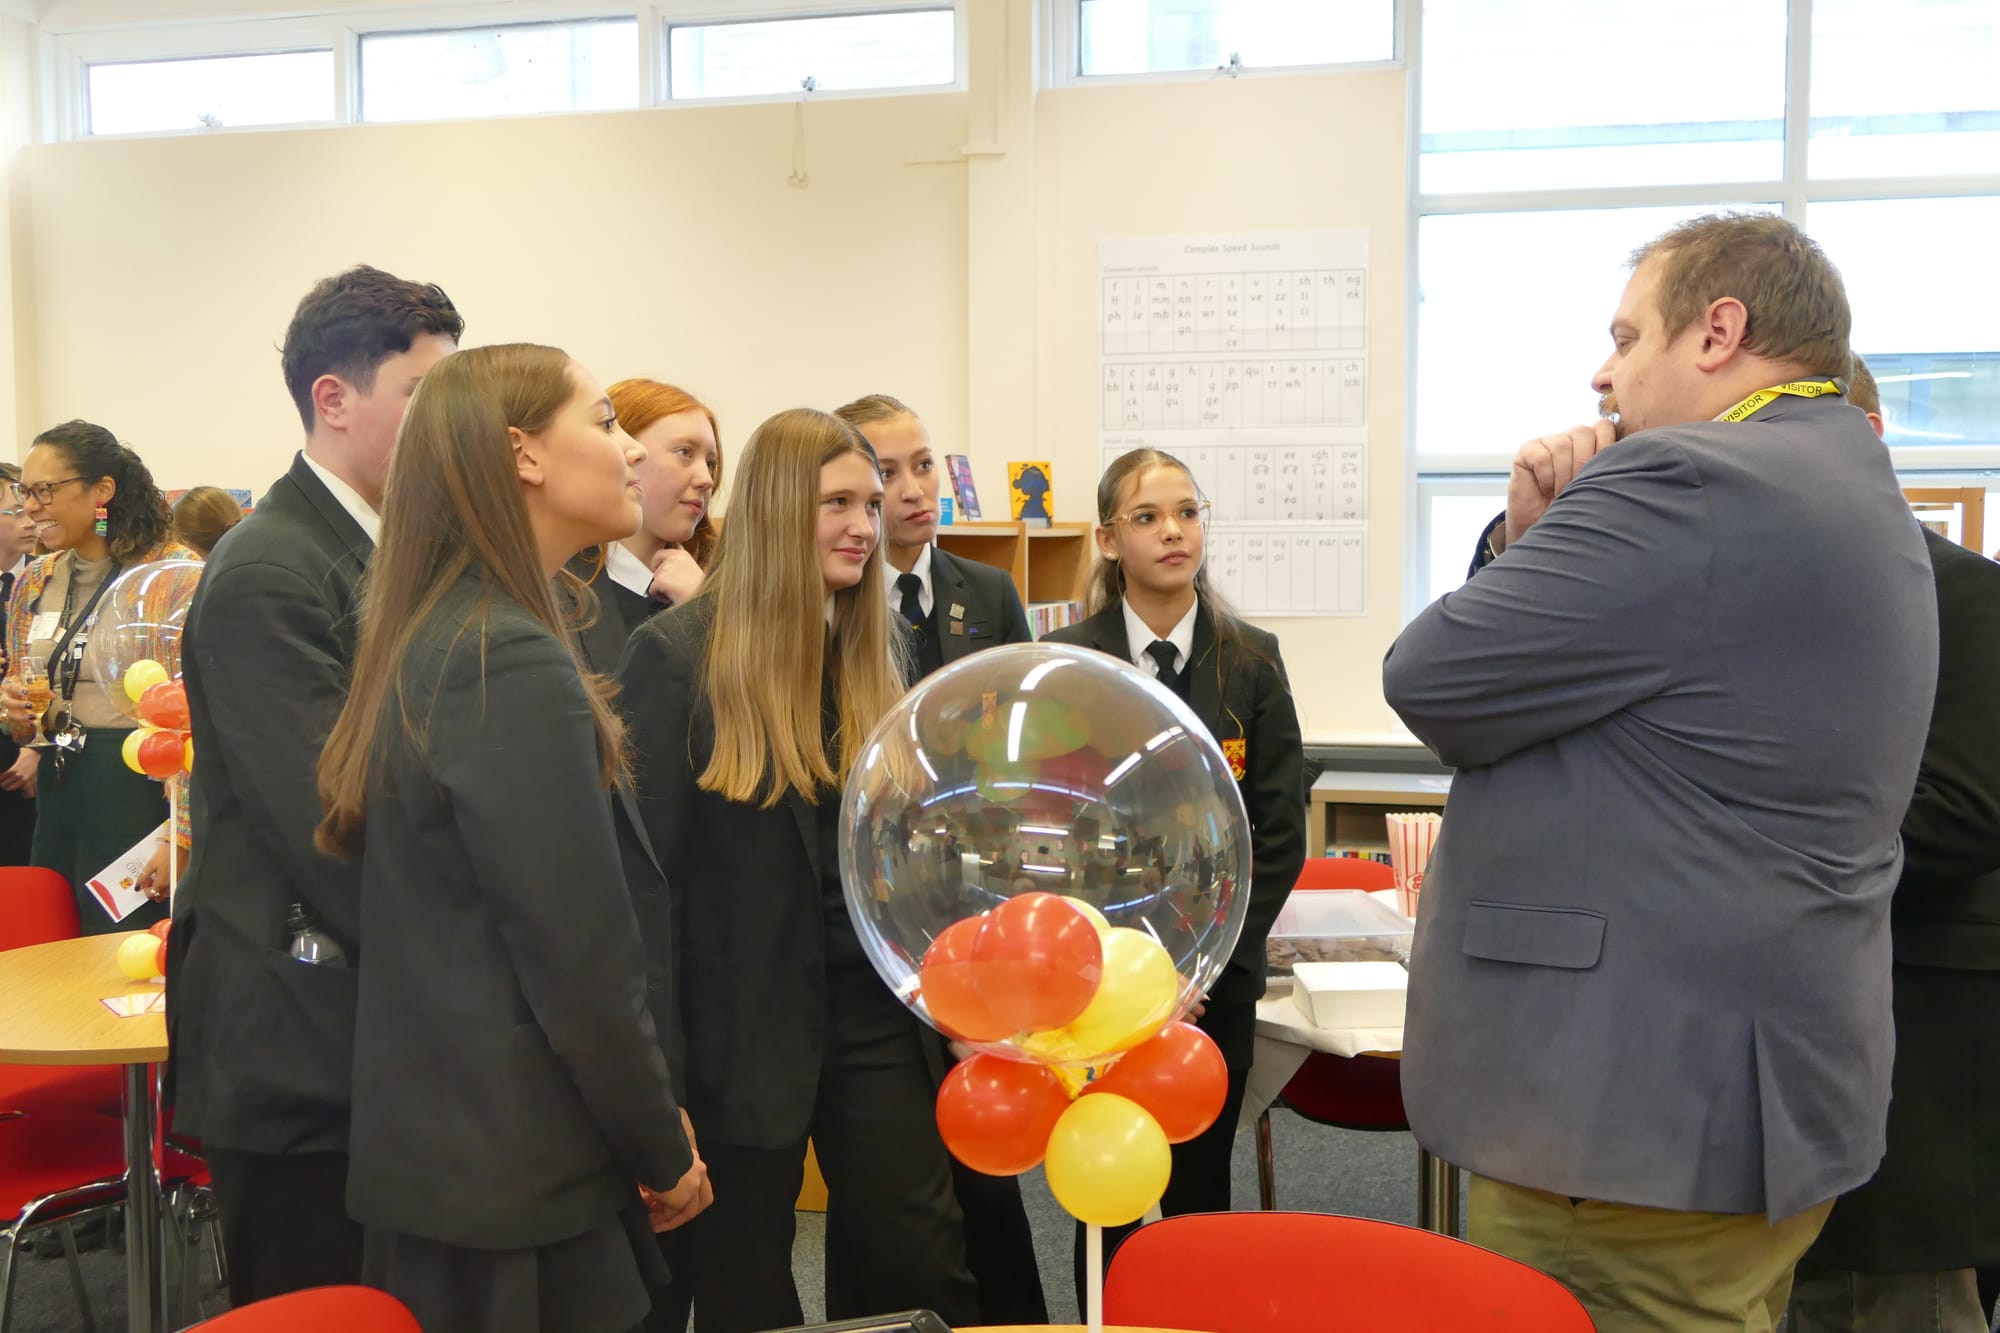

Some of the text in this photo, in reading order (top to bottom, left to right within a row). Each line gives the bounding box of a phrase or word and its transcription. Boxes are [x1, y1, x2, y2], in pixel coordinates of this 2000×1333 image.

[1184, 243, 1280, 254] Complex Speed Sounds
[1781, 383, 1823, 395] VISITOR
[1723, 394, 1764, 422] VISITOR
